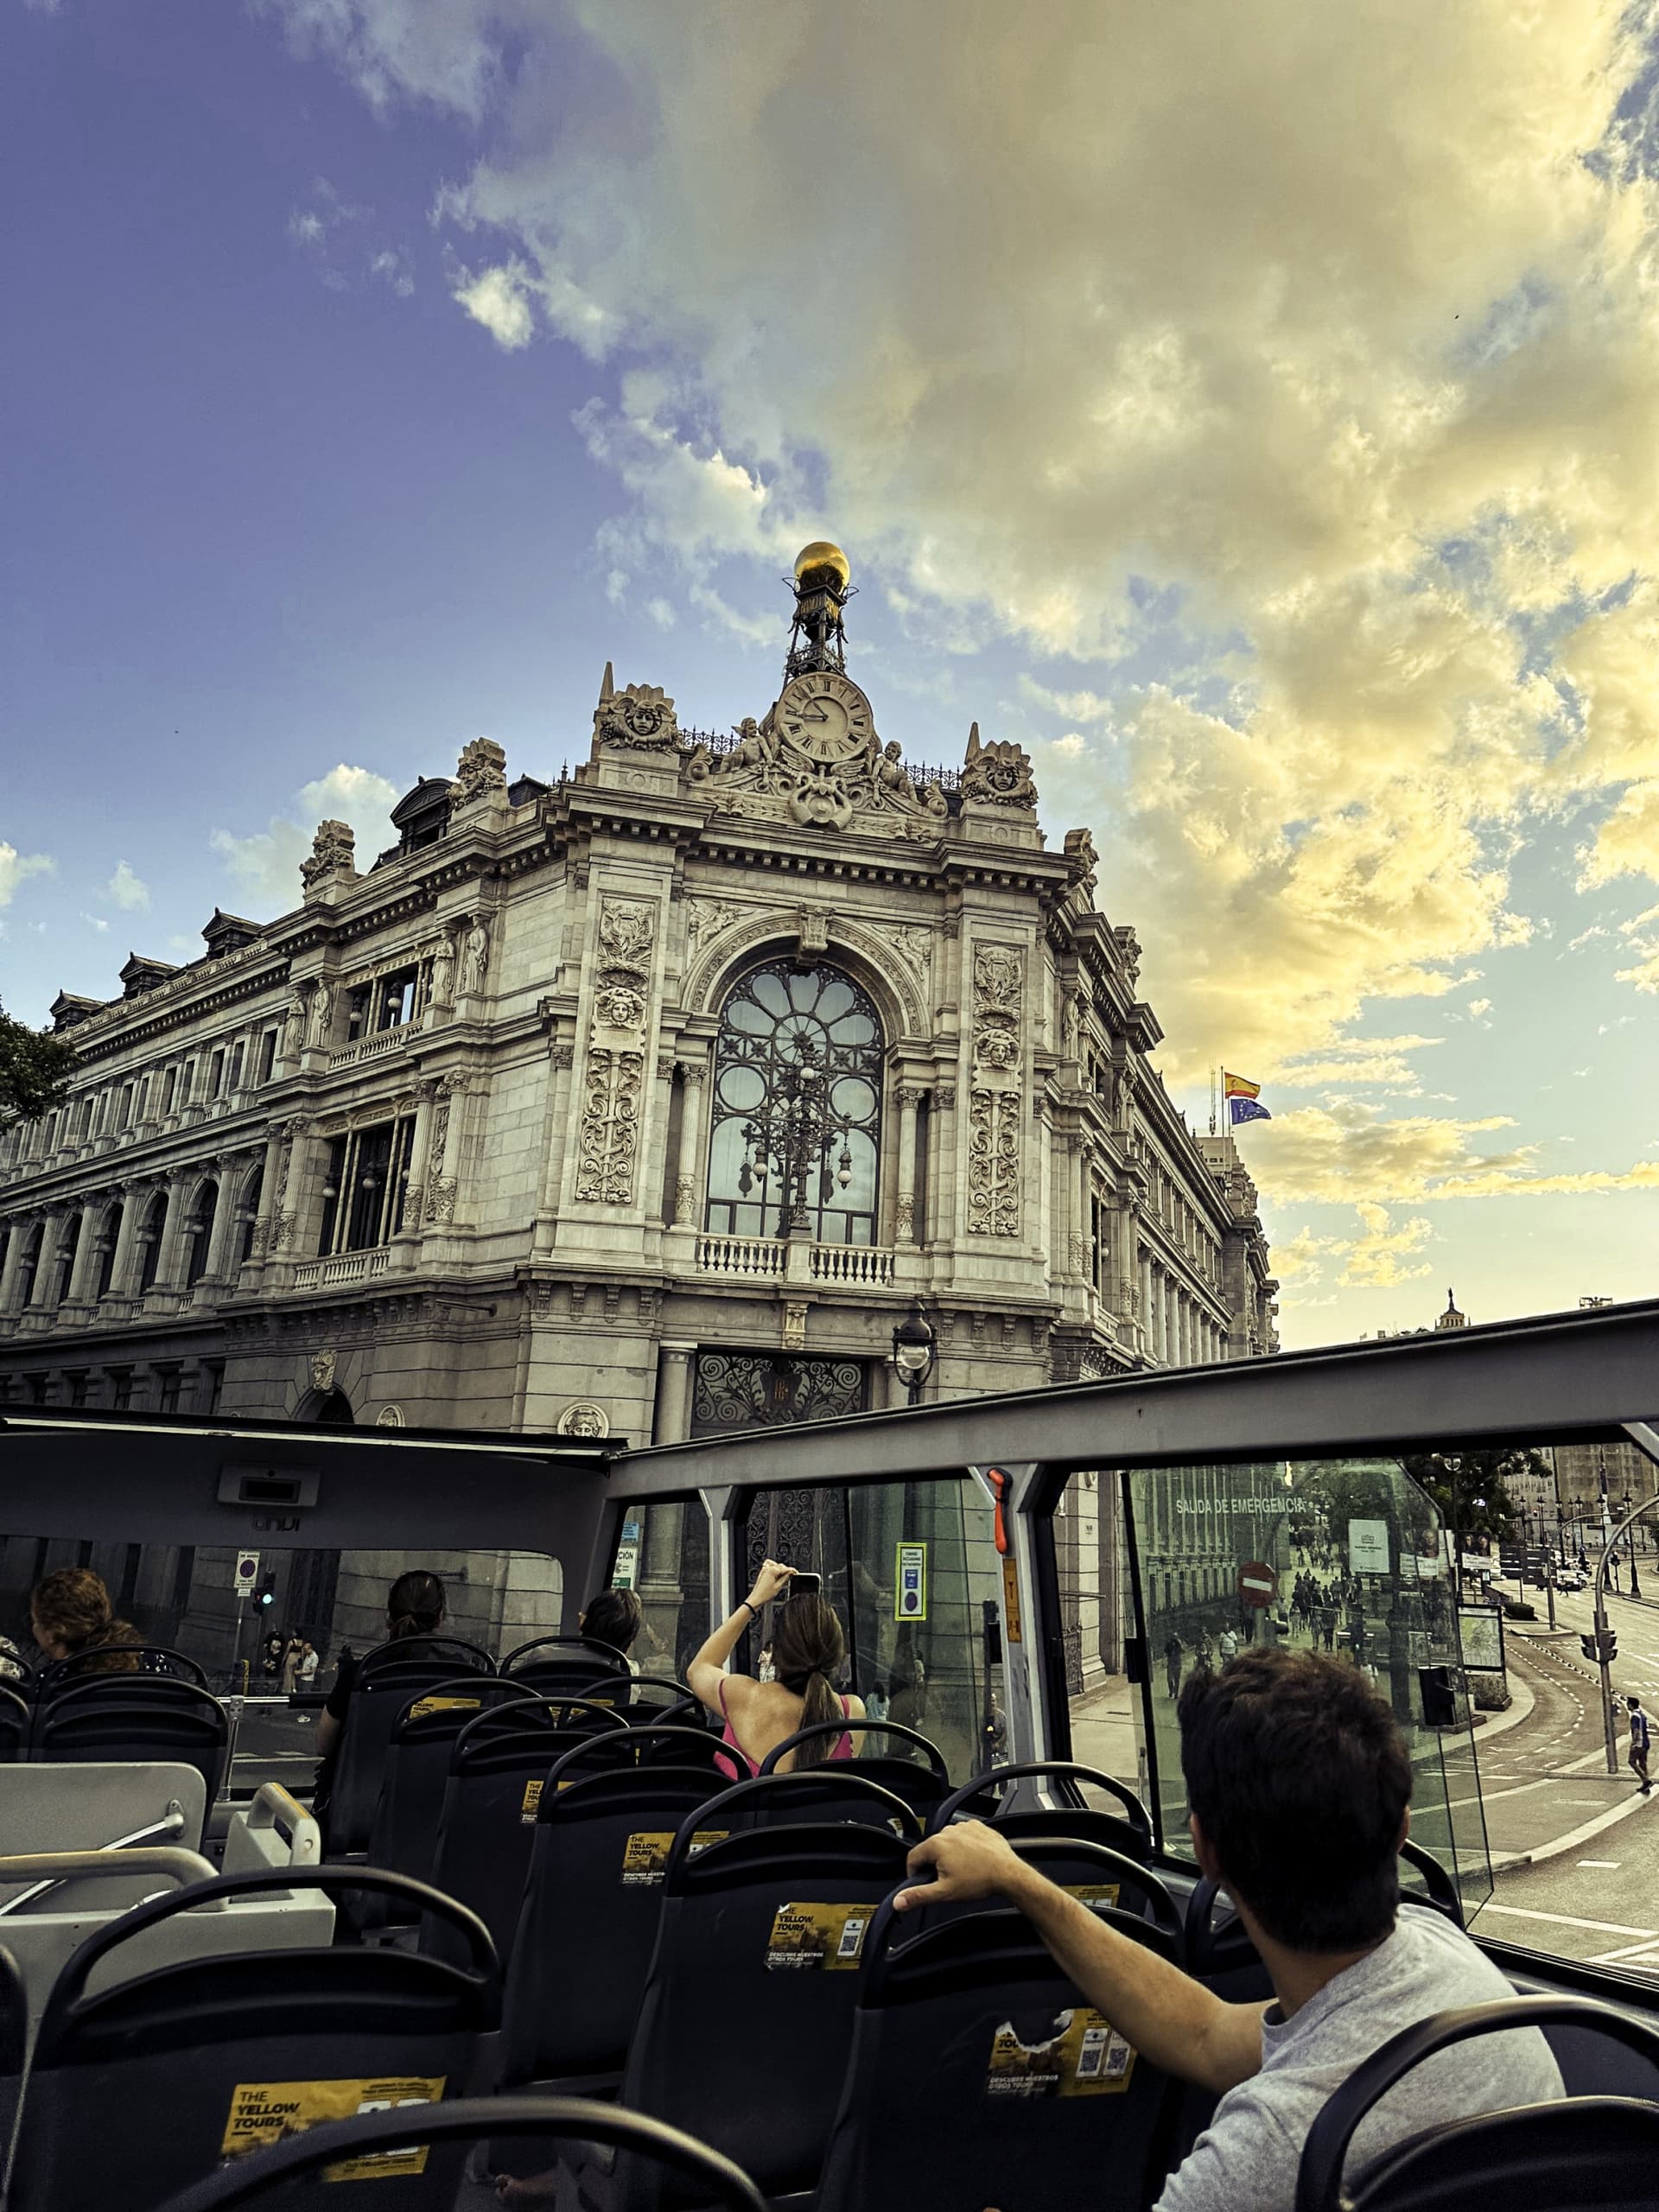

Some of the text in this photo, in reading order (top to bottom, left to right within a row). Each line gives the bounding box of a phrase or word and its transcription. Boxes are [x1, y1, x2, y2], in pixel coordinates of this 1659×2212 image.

[1176, 1497, 1306, 1514] SALIDA DE EMERGENCIA
[779, 1915, 815, 1923] YELLOW
[239, 2090, 270, 2102] THE
[237, 2101, 301, 2116] YELLOW
[234, 2116, 285, 2129] TOURS
